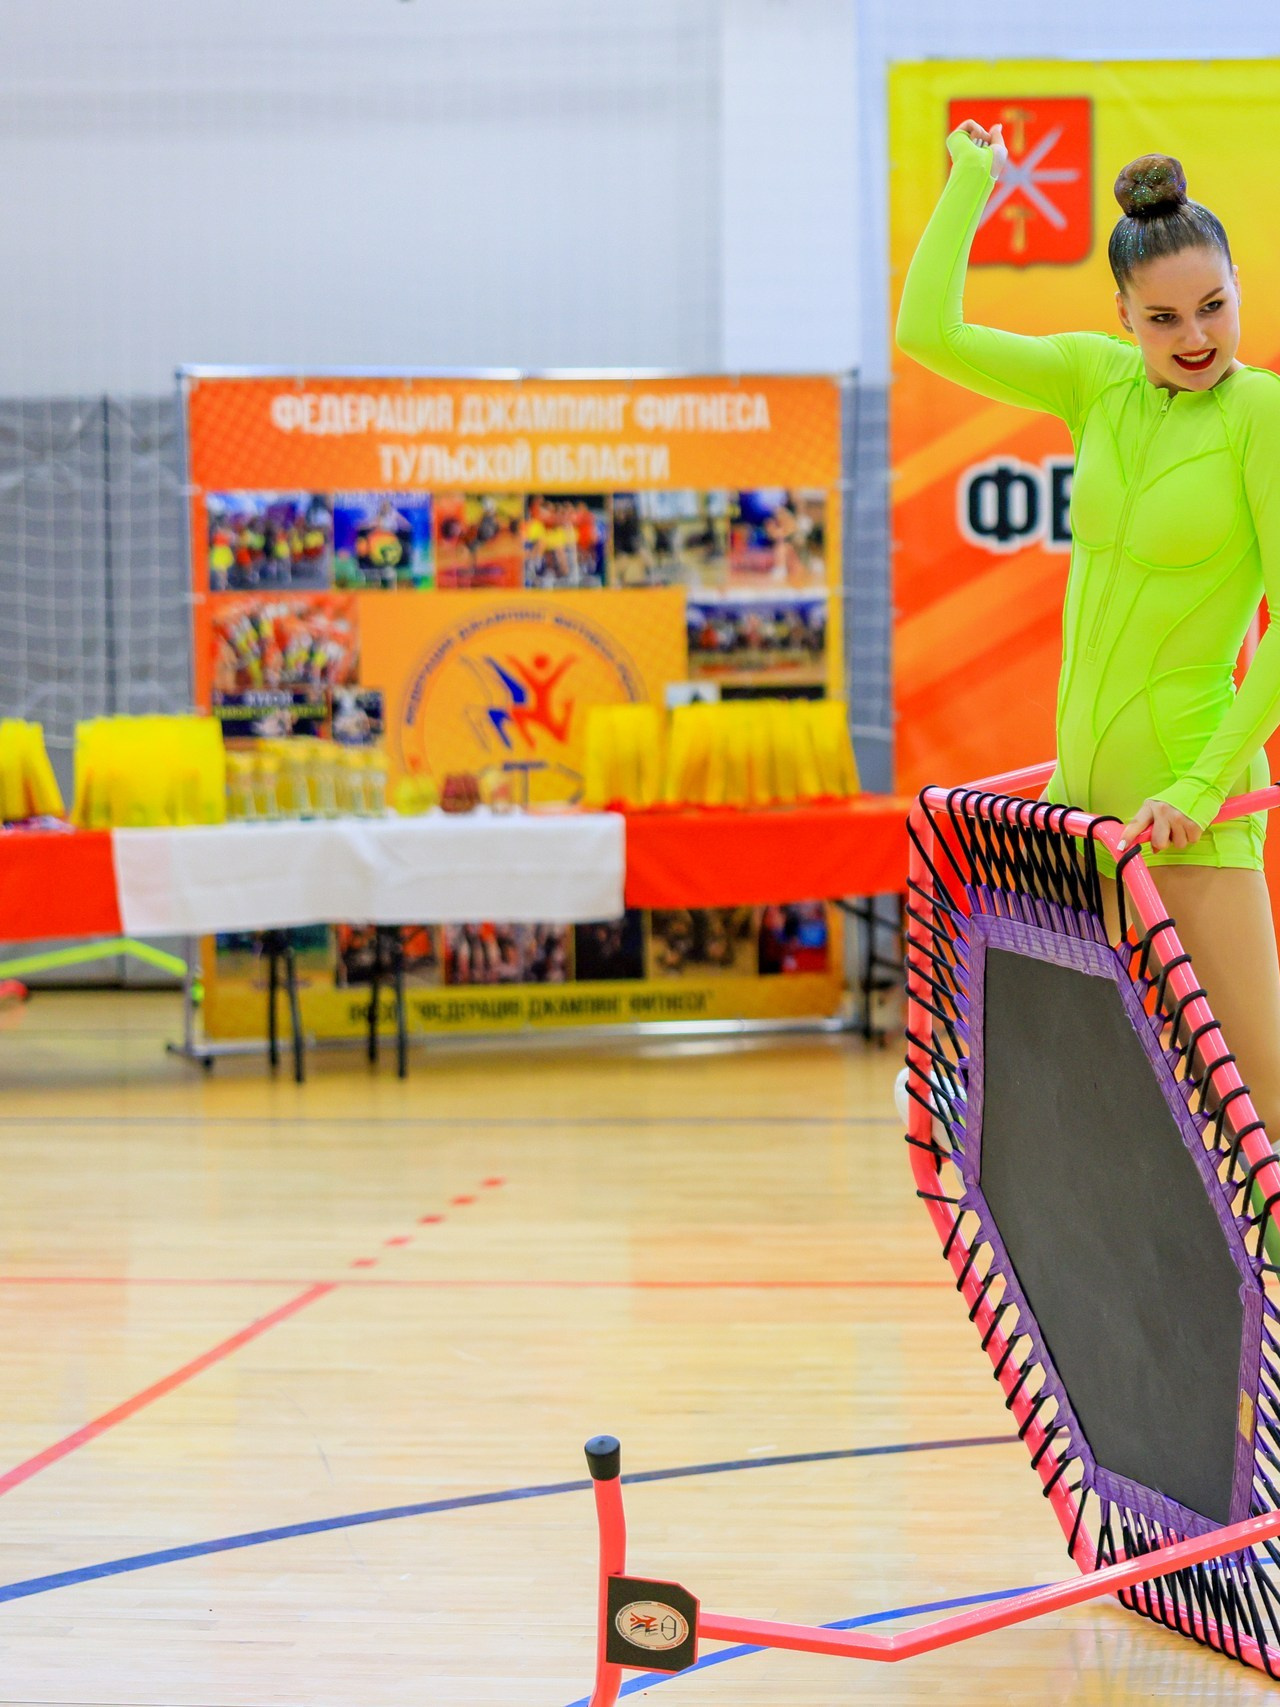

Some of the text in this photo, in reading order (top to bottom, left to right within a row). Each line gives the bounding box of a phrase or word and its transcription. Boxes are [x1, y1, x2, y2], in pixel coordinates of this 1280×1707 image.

[270, 393, 771, 436] ФЕДЕРАЦИЯ ДЖАМПИНГ ФИТНЕСА
[378, 440, 671, 482] ТУЛЬСКОЙ ОБЛАСТИ
